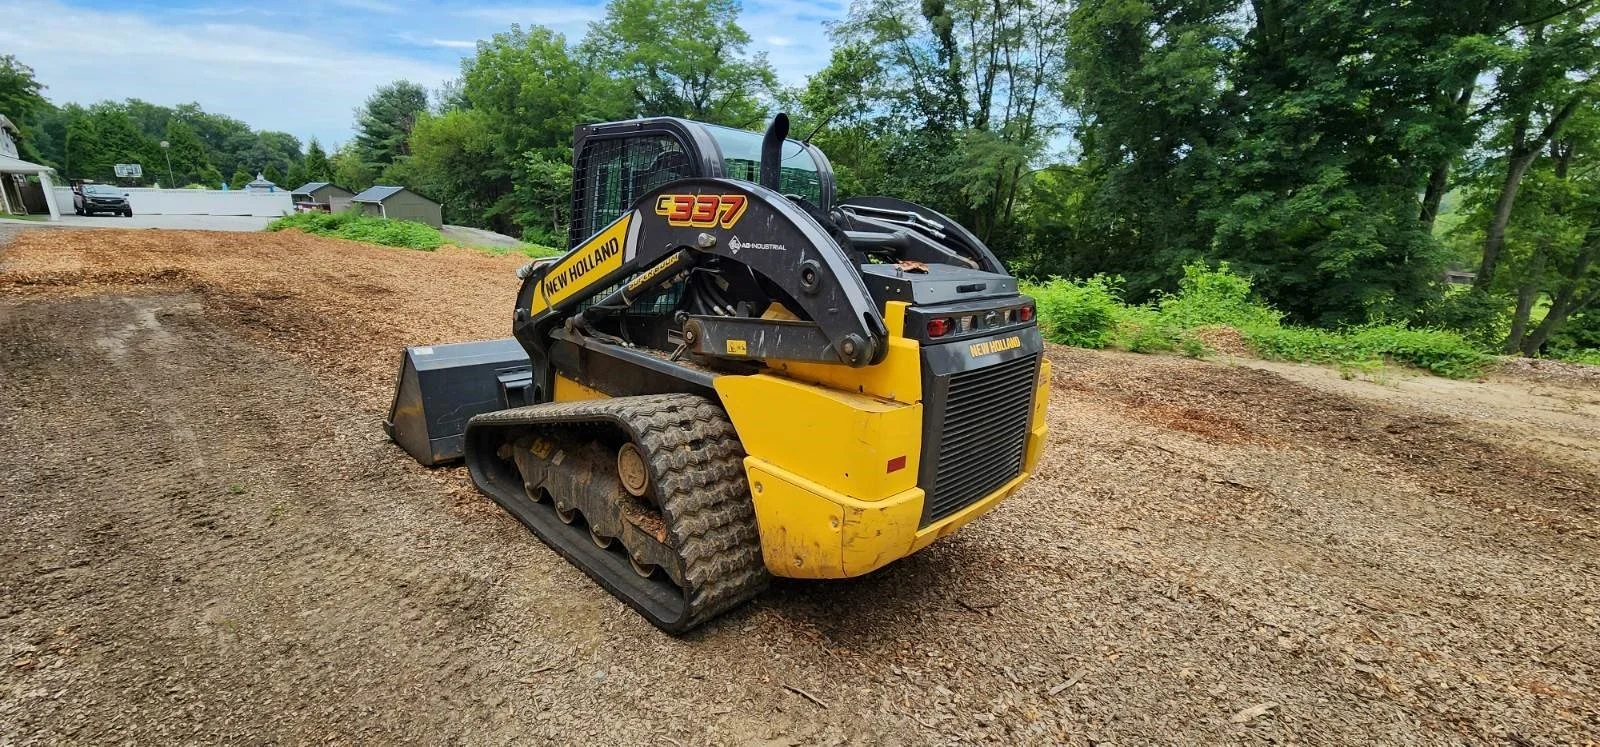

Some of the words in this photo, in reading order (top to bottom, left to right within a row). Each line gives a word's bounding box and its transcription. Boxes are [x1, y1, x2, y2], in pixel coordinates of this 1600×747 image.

[655, 194, 748, 229] C337
[545, 271, 568, 296] NEW
[568, 237, 619, 282] HOLLAND
[969, 341, 991, 358] NEW
[989, 336, 1021, 353] HOLLAND
